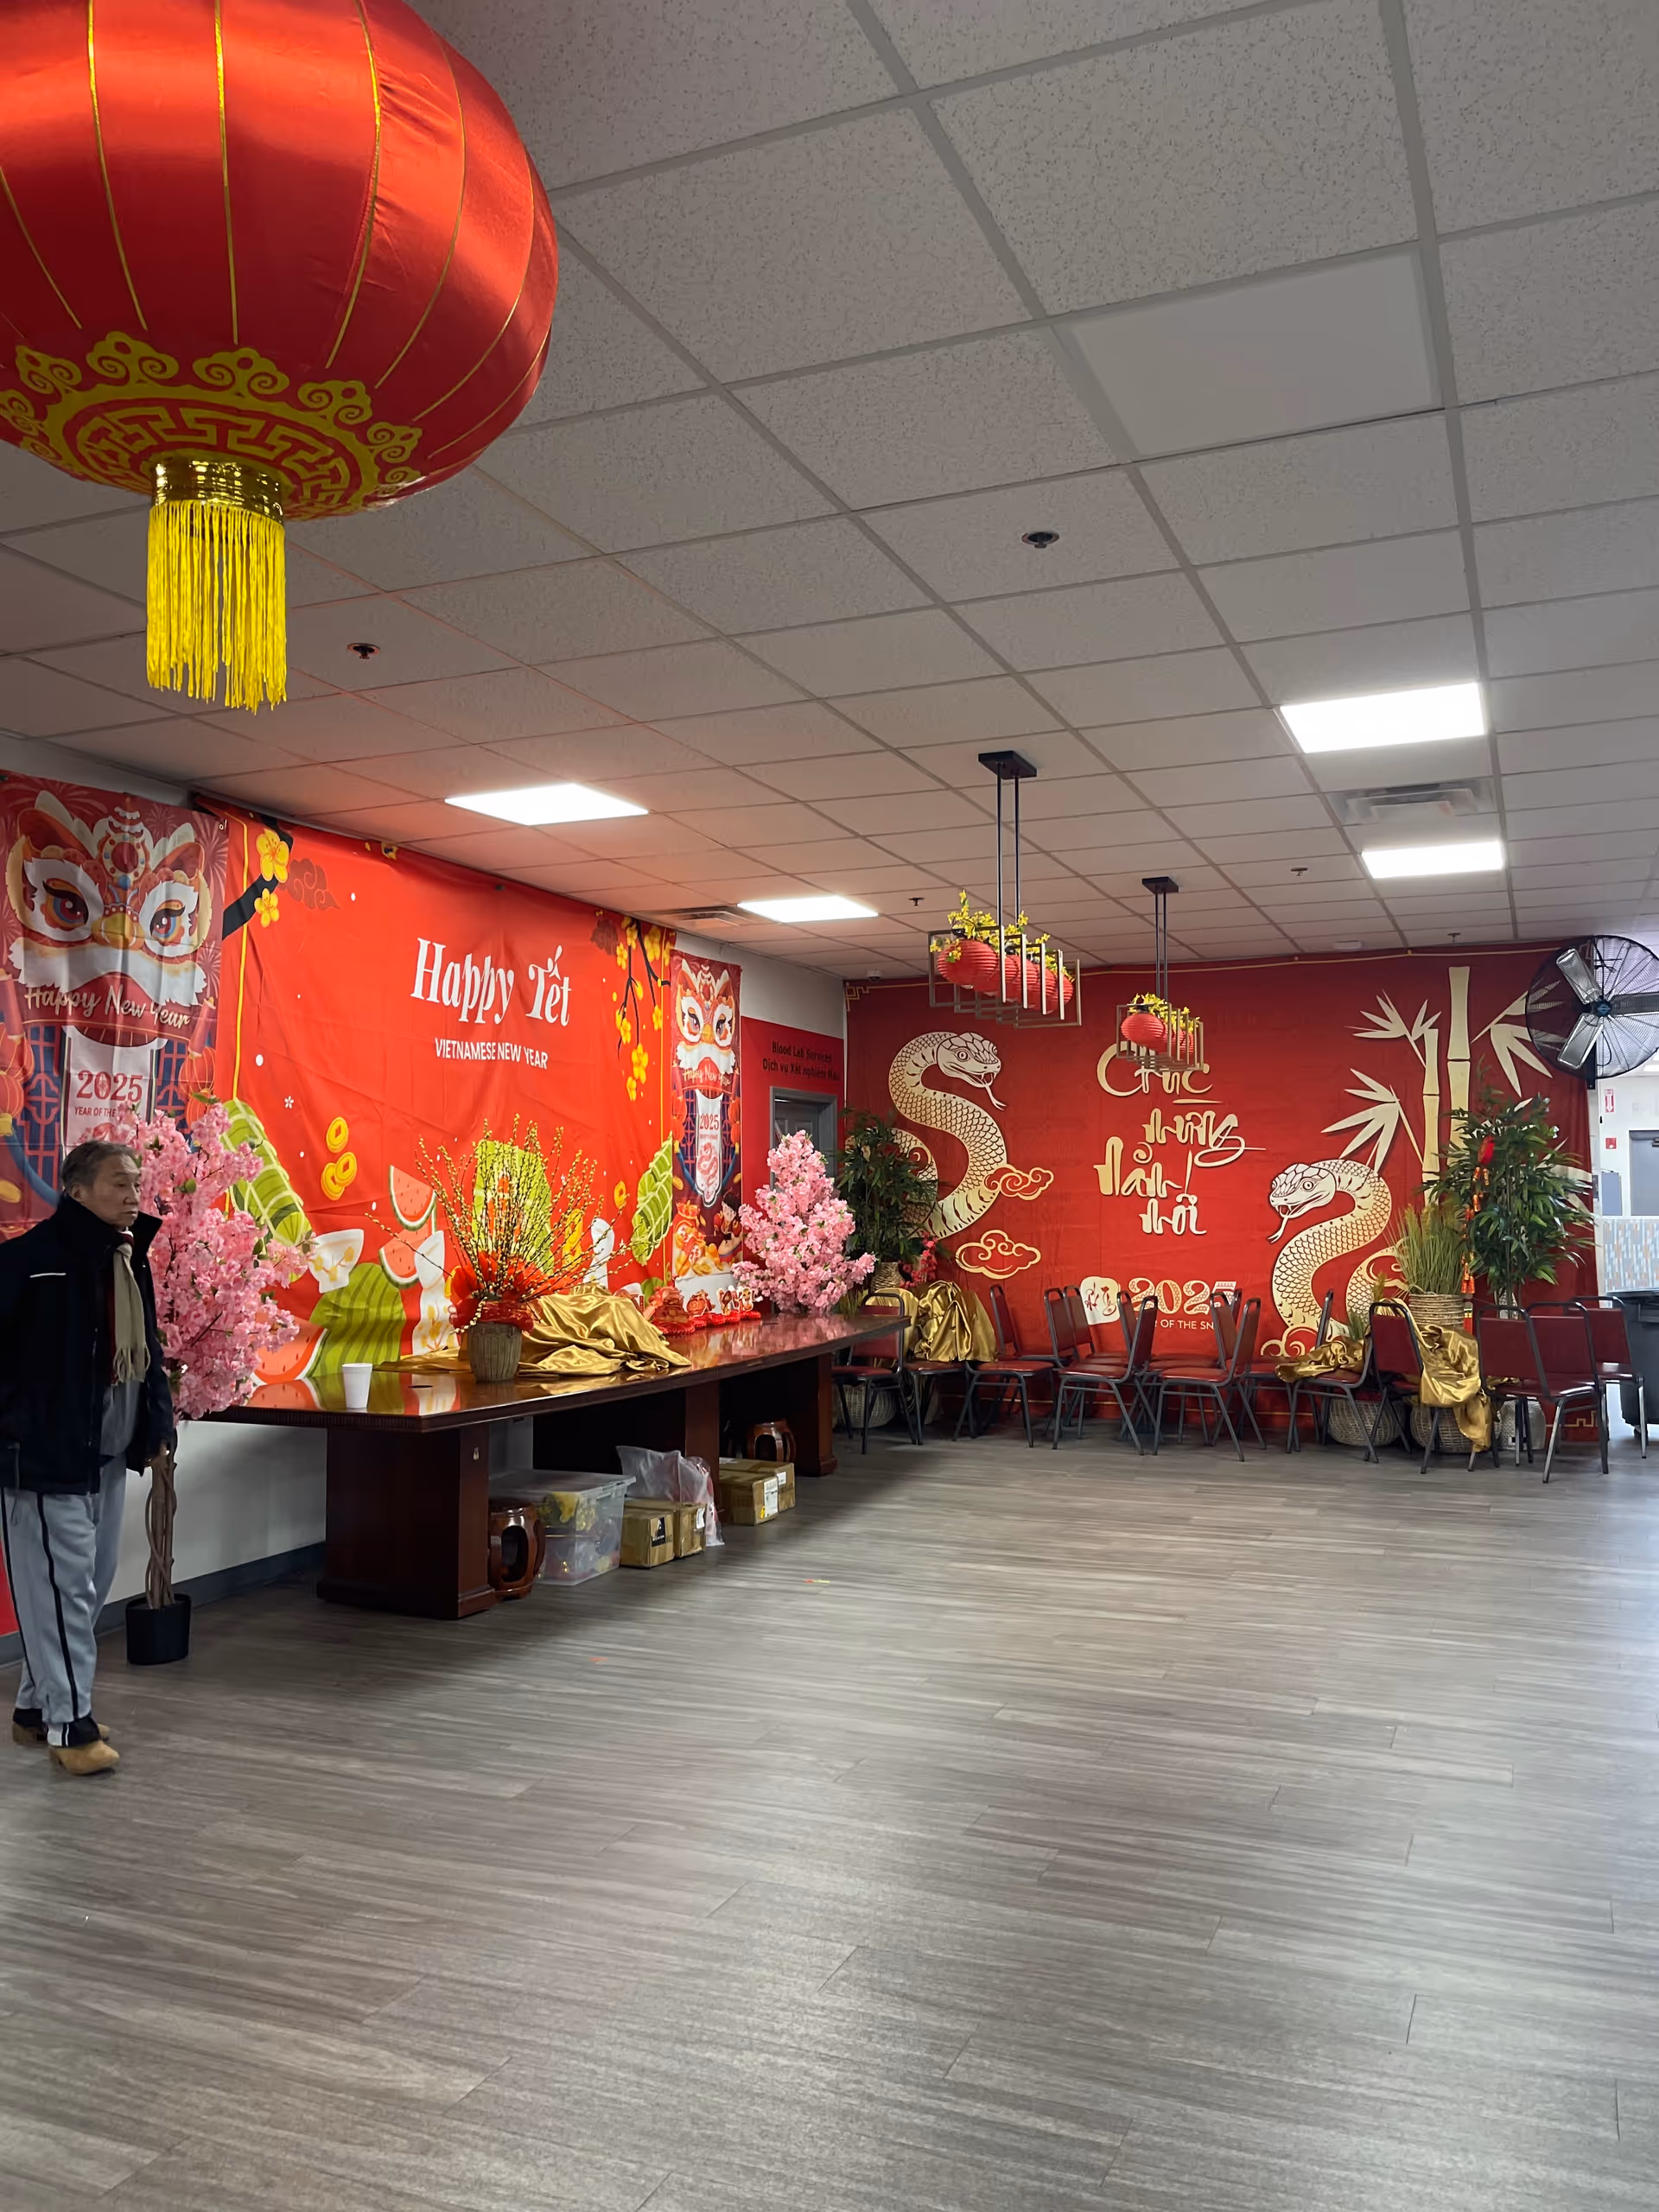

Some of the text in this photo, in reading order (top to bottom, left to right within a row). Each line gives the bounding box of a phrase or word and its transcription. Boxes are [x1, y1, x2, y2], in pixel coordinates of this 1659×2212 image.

[410, 938, 572, 1027] Happy Tết
[24, 985, 190, 1028] Happy New Year
[435, 1038, 549, 1070] VIETNAMESE NEW YEAR
[772, 1040, 791, 1056] Blood
[793, 1046, 804, 1058] Lab
[76, 1070, 143, 1103] 2025
[74, 1107, 116, 1117] YEAR OF THE
[699, 1113, 720, 1130] 2025
[1160, 1319, 1175, 1328] OF
[1177, 1320, 1197, 1329] THE
